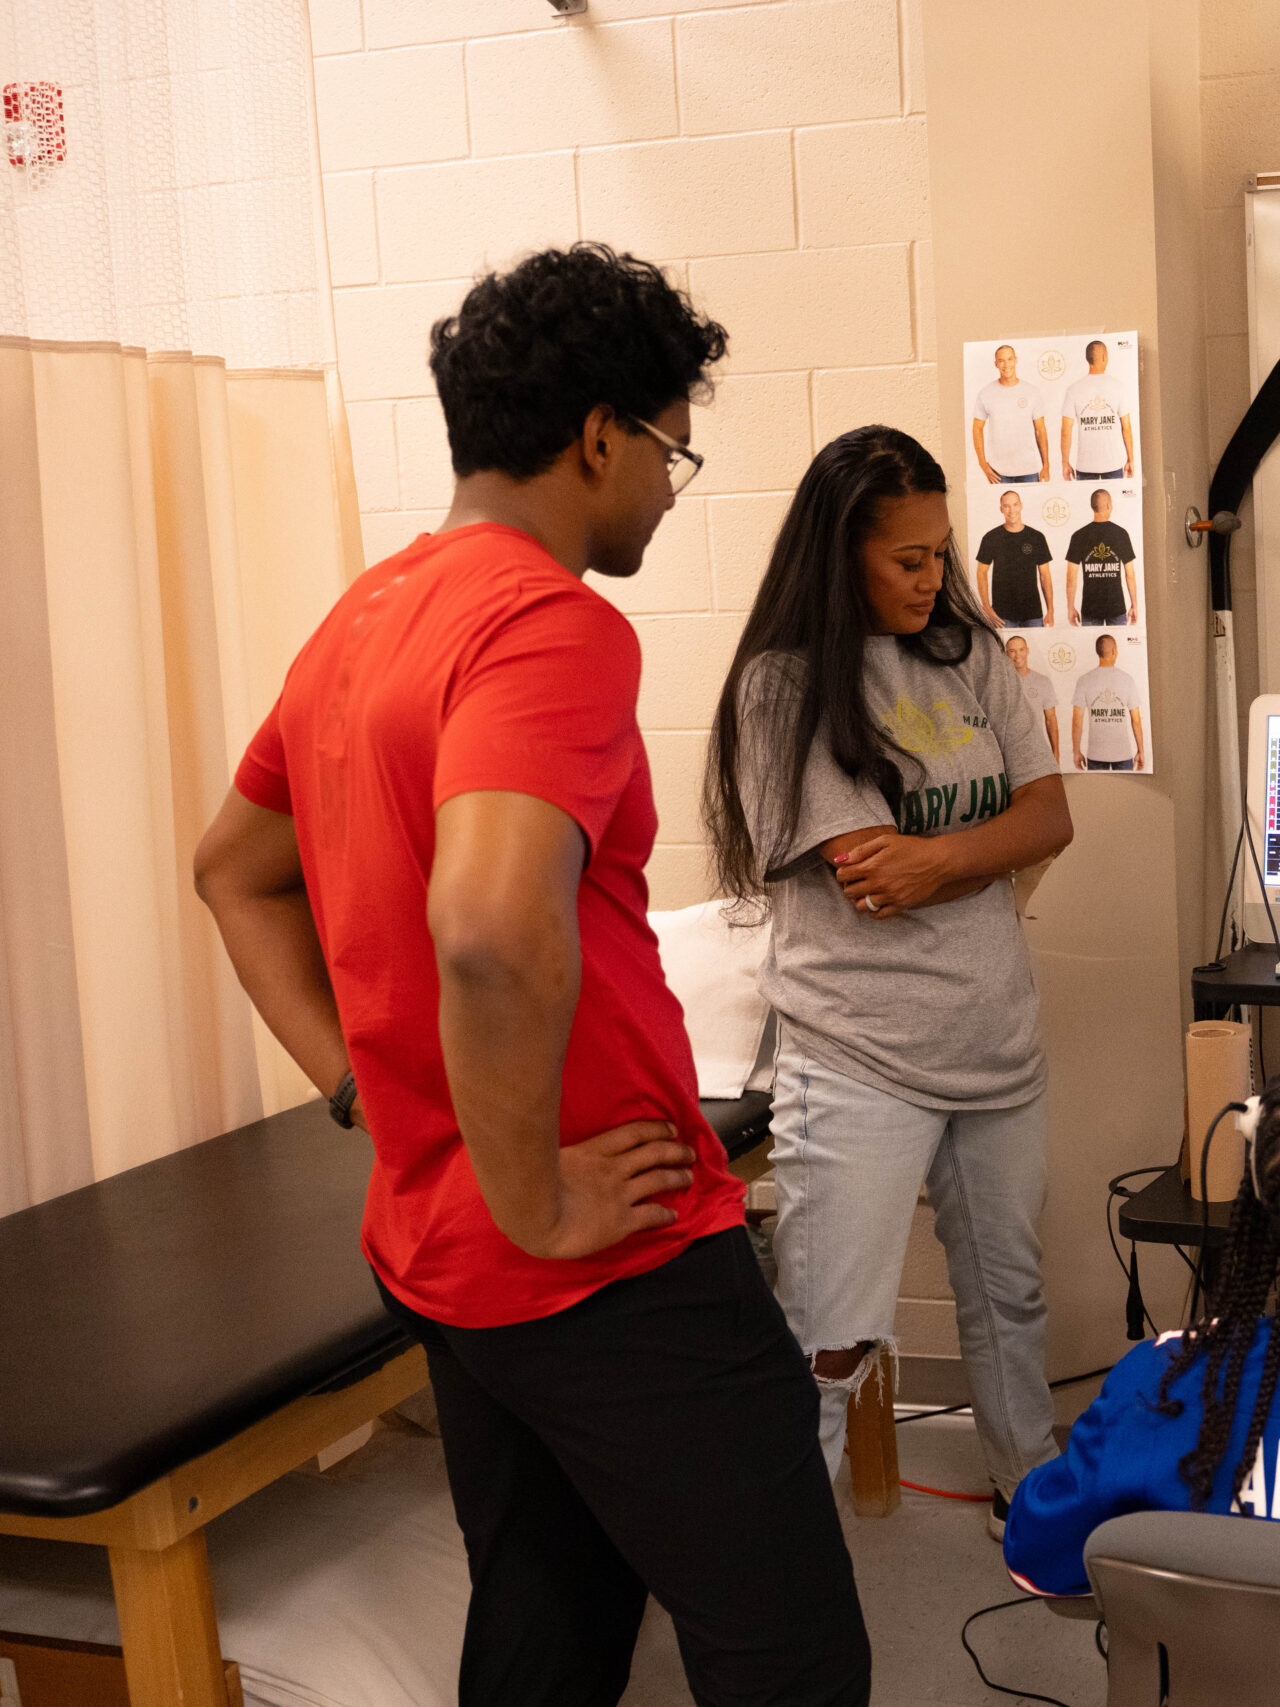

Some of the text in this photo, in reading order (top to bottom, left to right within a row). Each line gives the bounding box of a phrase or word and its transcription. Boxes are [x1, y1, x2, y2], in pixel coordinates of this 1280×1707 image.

[1080, 415, 1115, 426] MARY JANE
[1085, 561, 1120, 573] MARY JANE
[1091, 707, 1125, 717] MARY JANE
[963, 715, 988, 728] MAR
[901, 773, 1011, 834] ARY JAN
